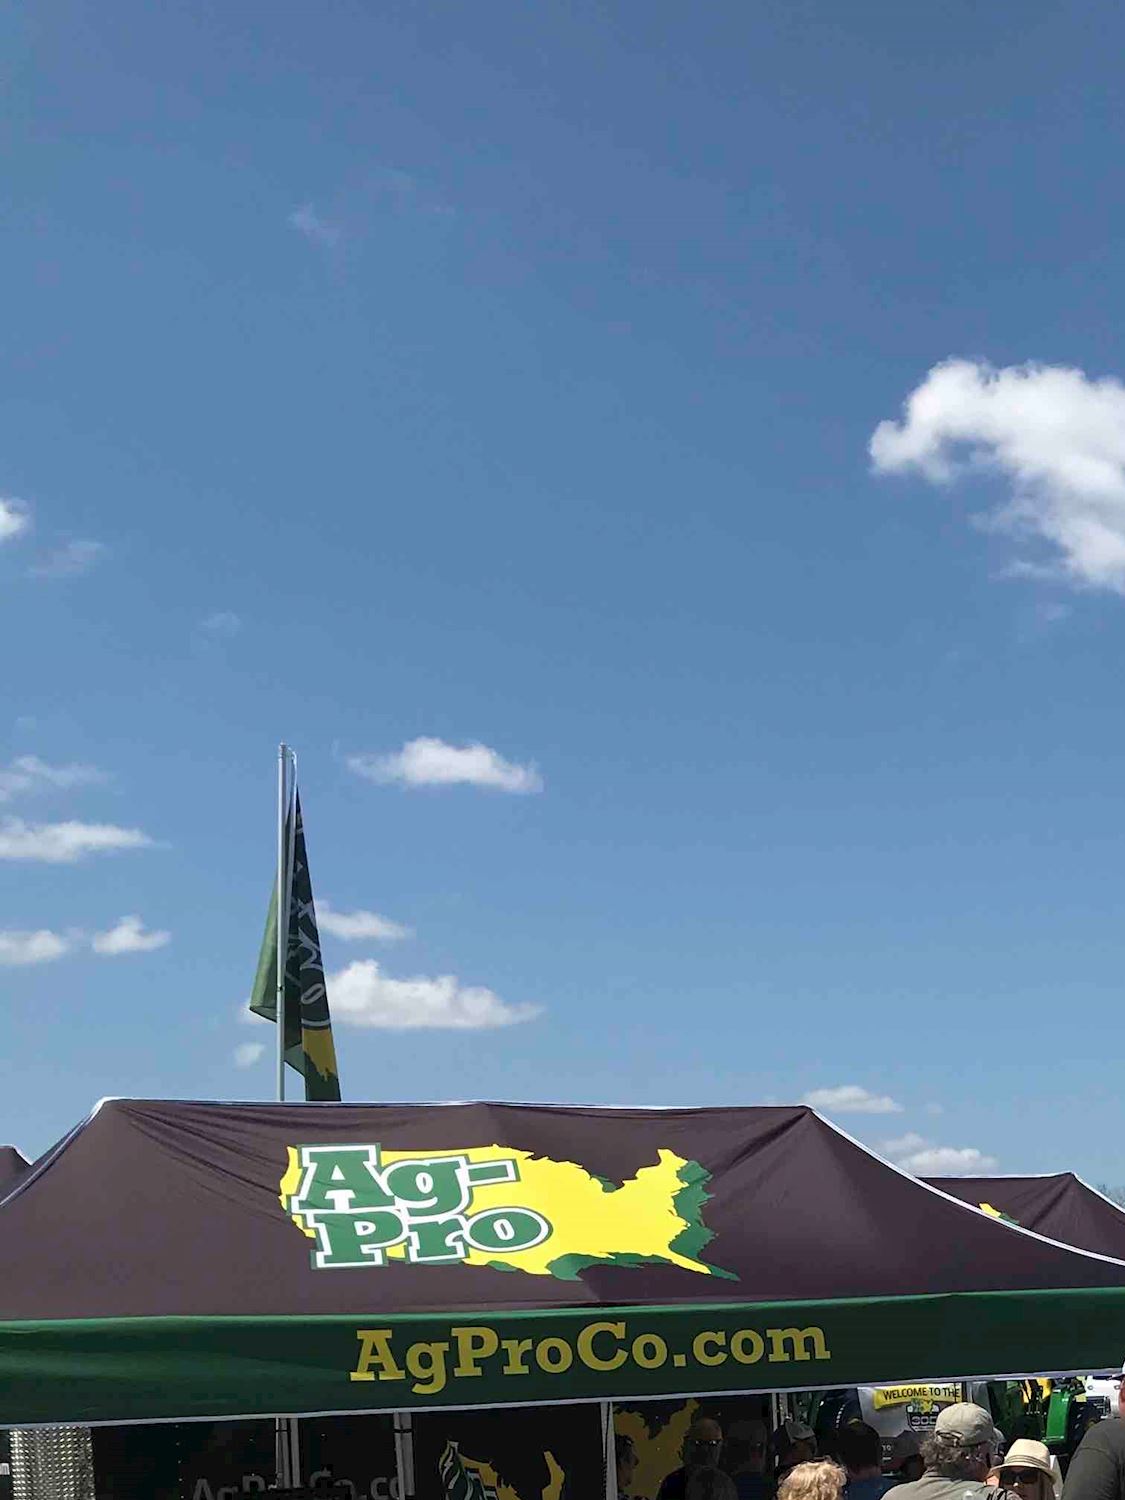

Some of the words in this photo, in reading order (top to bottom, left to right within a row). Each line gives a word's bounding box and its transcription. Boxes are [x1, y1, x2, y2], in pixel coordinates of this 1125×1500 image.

[290, 1144, 519, 1217] Ag-
[307, 1206, 550, 1268] Pro
[349, 1321, 831, 1395] AgProCo.com
[883, 1387, 928, 1400] WELCOME
[929, 1387, 941, 1396] TO
[942, 1387, 960, 1398] THE
